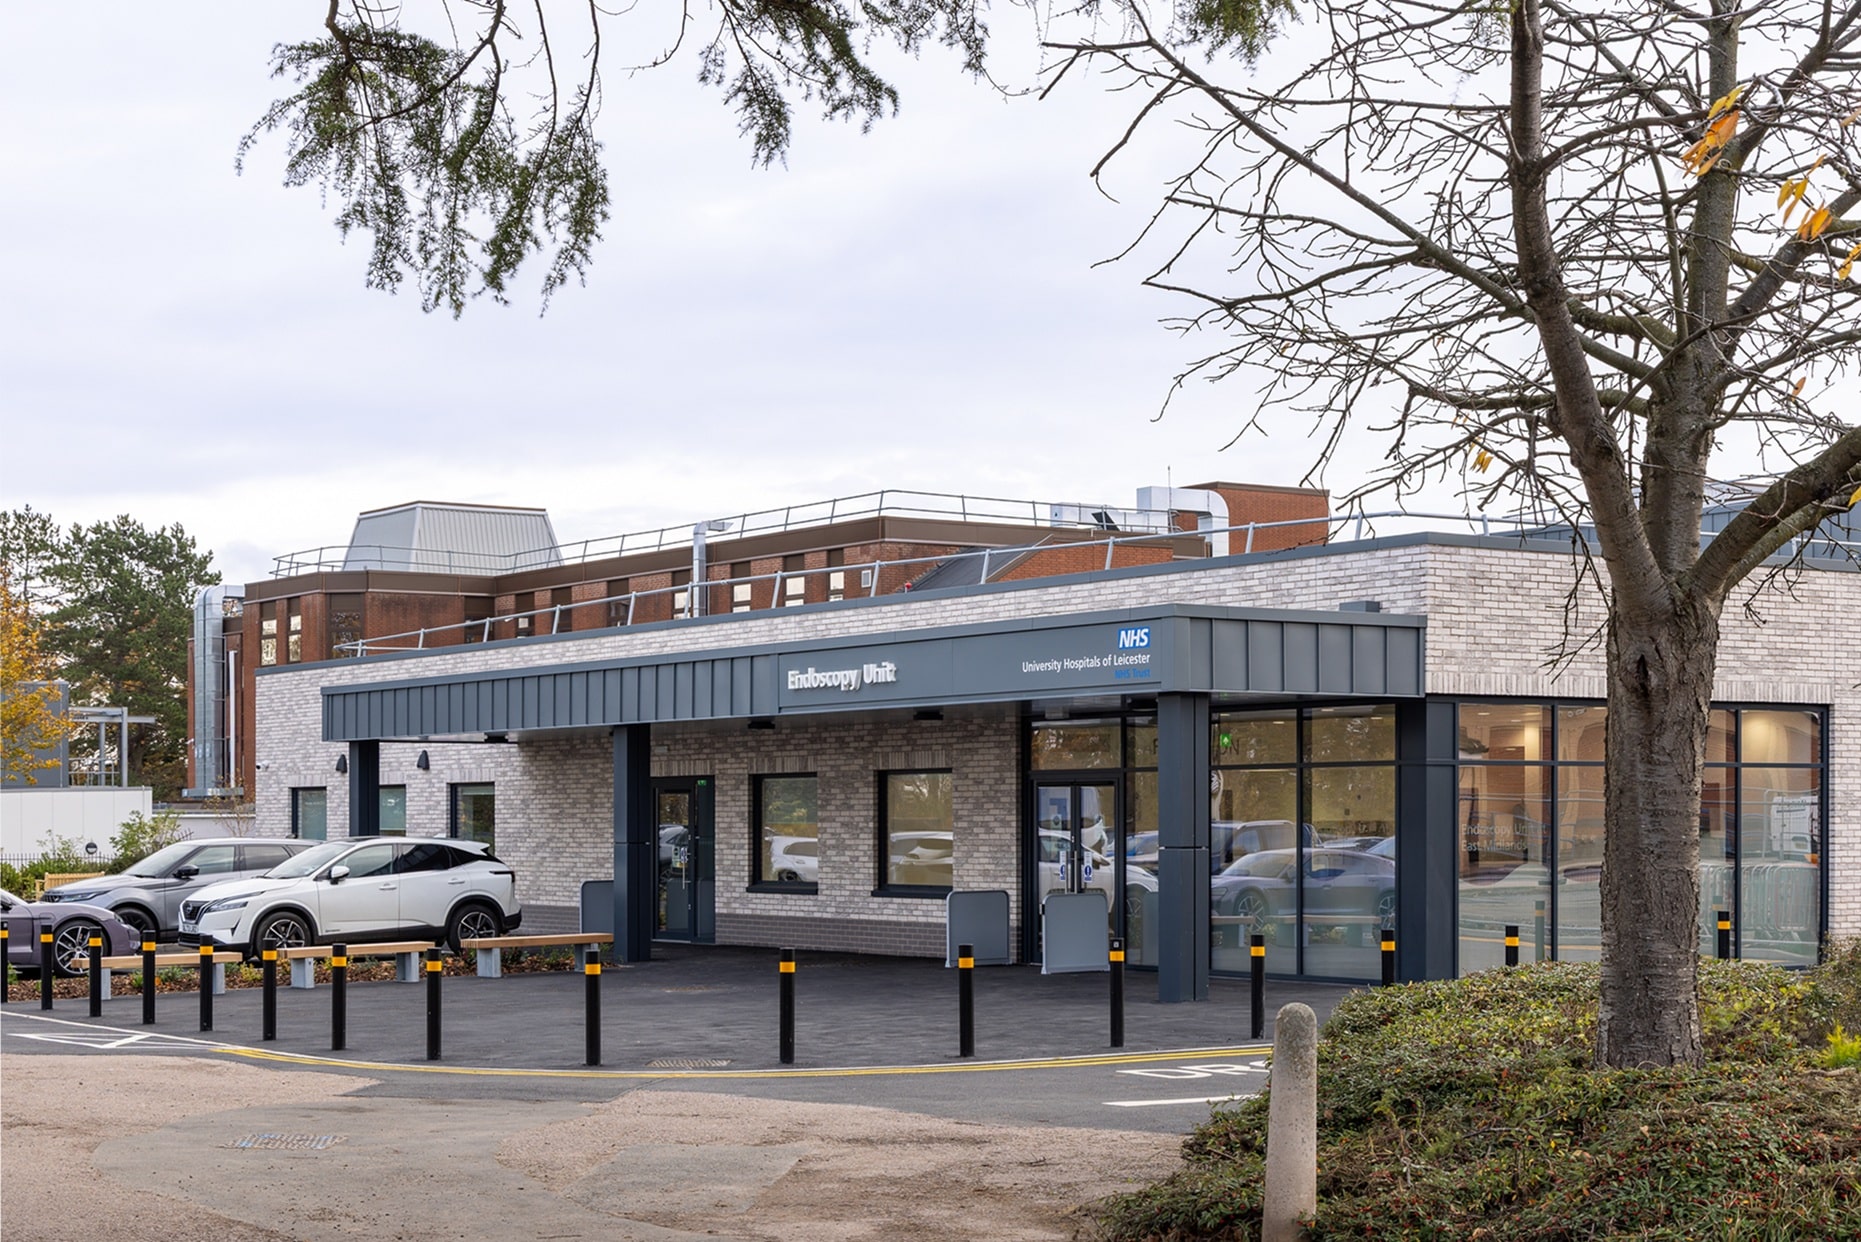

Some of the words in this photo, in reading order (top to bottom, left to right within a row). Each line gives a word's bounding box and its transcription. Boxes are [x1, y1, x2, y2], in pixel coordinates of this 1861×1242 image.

[1118, 628, 1150, 648] NHS
[1022, 654, 1062, 673] University
[1063, 654, 1101, 671] Hospitals
[1102, 654, 1112, 666] of
[1113, 653, 1151, 666] Leicester
[787, 667, 862, 692] Endoscopy
[862, 661, 897, 684] Unit
[1114, 669, 1131, 679] NHS
[1132, 668, 1151, 678] Trust
[1461, 823, 1512, 838] Endoscopy
[1461, 839, 1480, 852] East
[1483, 839, 1528, 852] Midlands
[1115, 1060, 1269, 1079] DR
